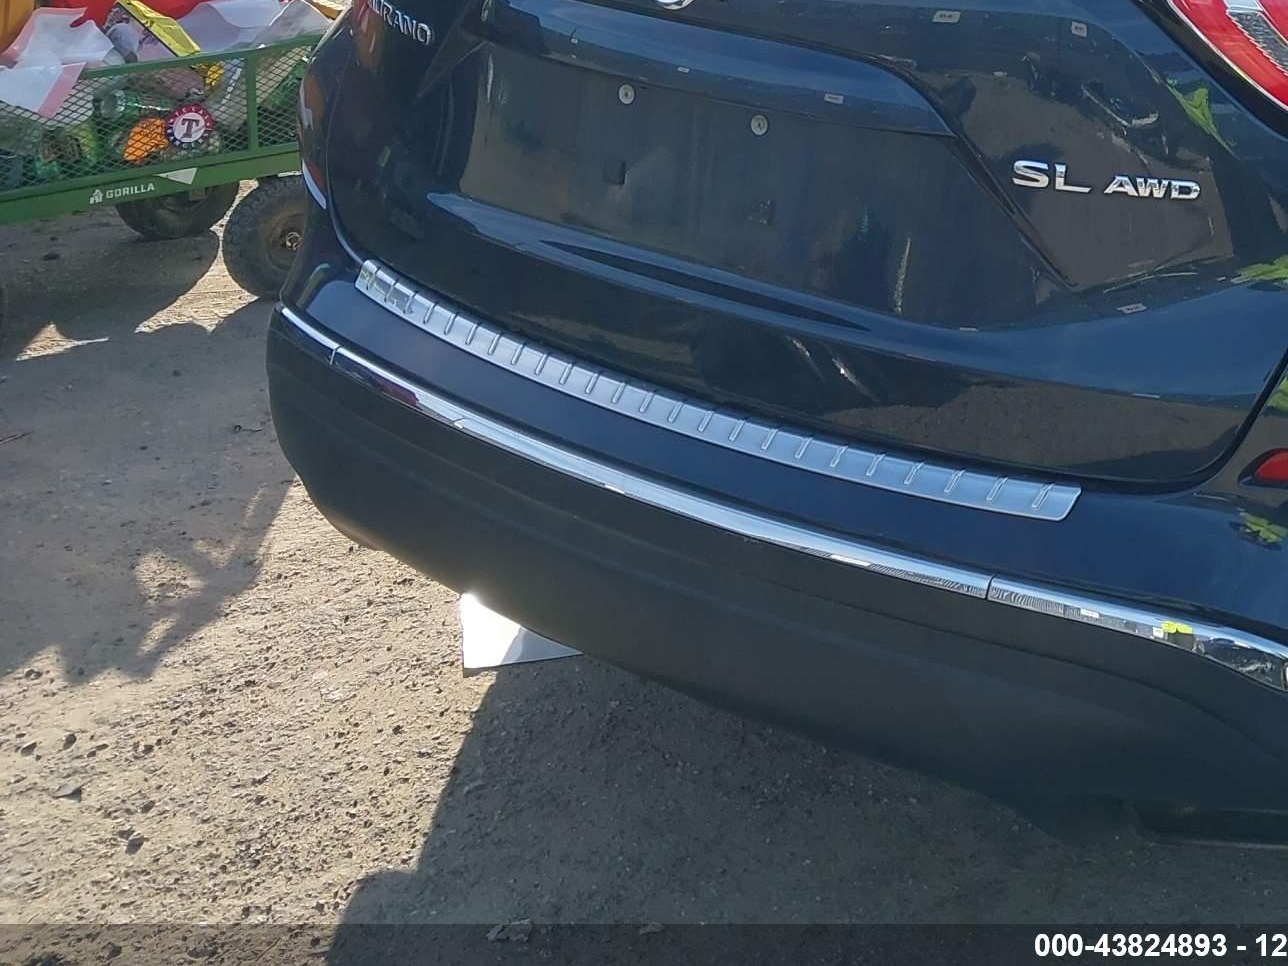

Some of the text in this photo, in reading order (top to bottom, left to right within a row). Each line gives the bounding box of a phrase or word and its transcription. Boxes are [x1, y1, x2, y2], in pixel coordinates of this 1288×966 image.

[181, 117, 201, 139] T
[105, 183, 155, 199] GORILLA
[1012, 160, 1201, 200] SL AWD
